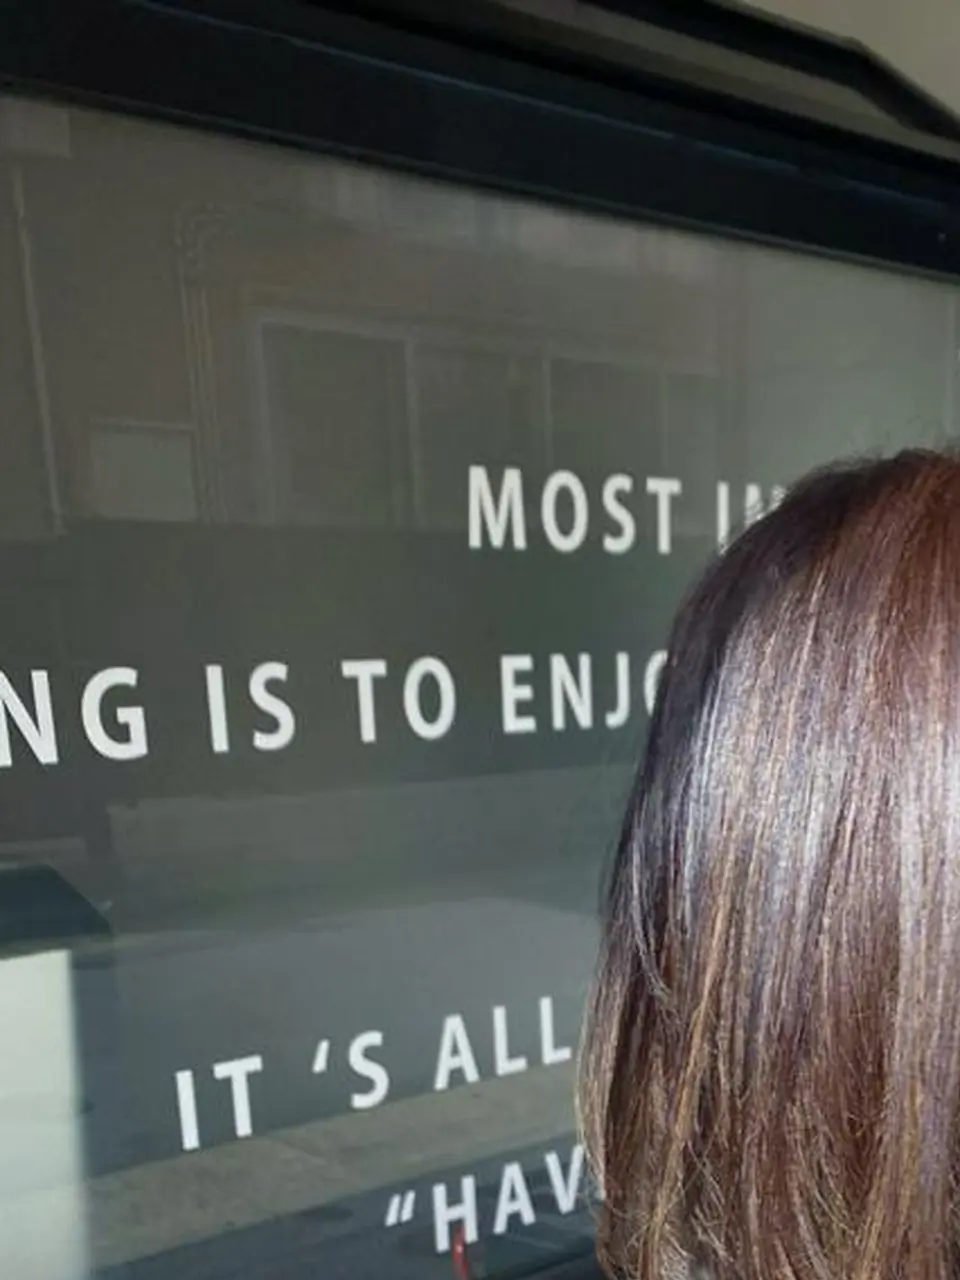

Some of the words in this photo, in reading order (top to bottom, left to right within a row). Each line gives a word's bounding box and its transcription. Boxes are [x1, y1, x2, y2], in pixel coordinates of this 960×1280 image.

[468, 465, 681, 554] MOST
[206, 661, 295, 753] IS
[341, 657, 456, 742] TO
[176, 1055, 262, 1150] IT
[434, 997, 571, 1090] ALL
